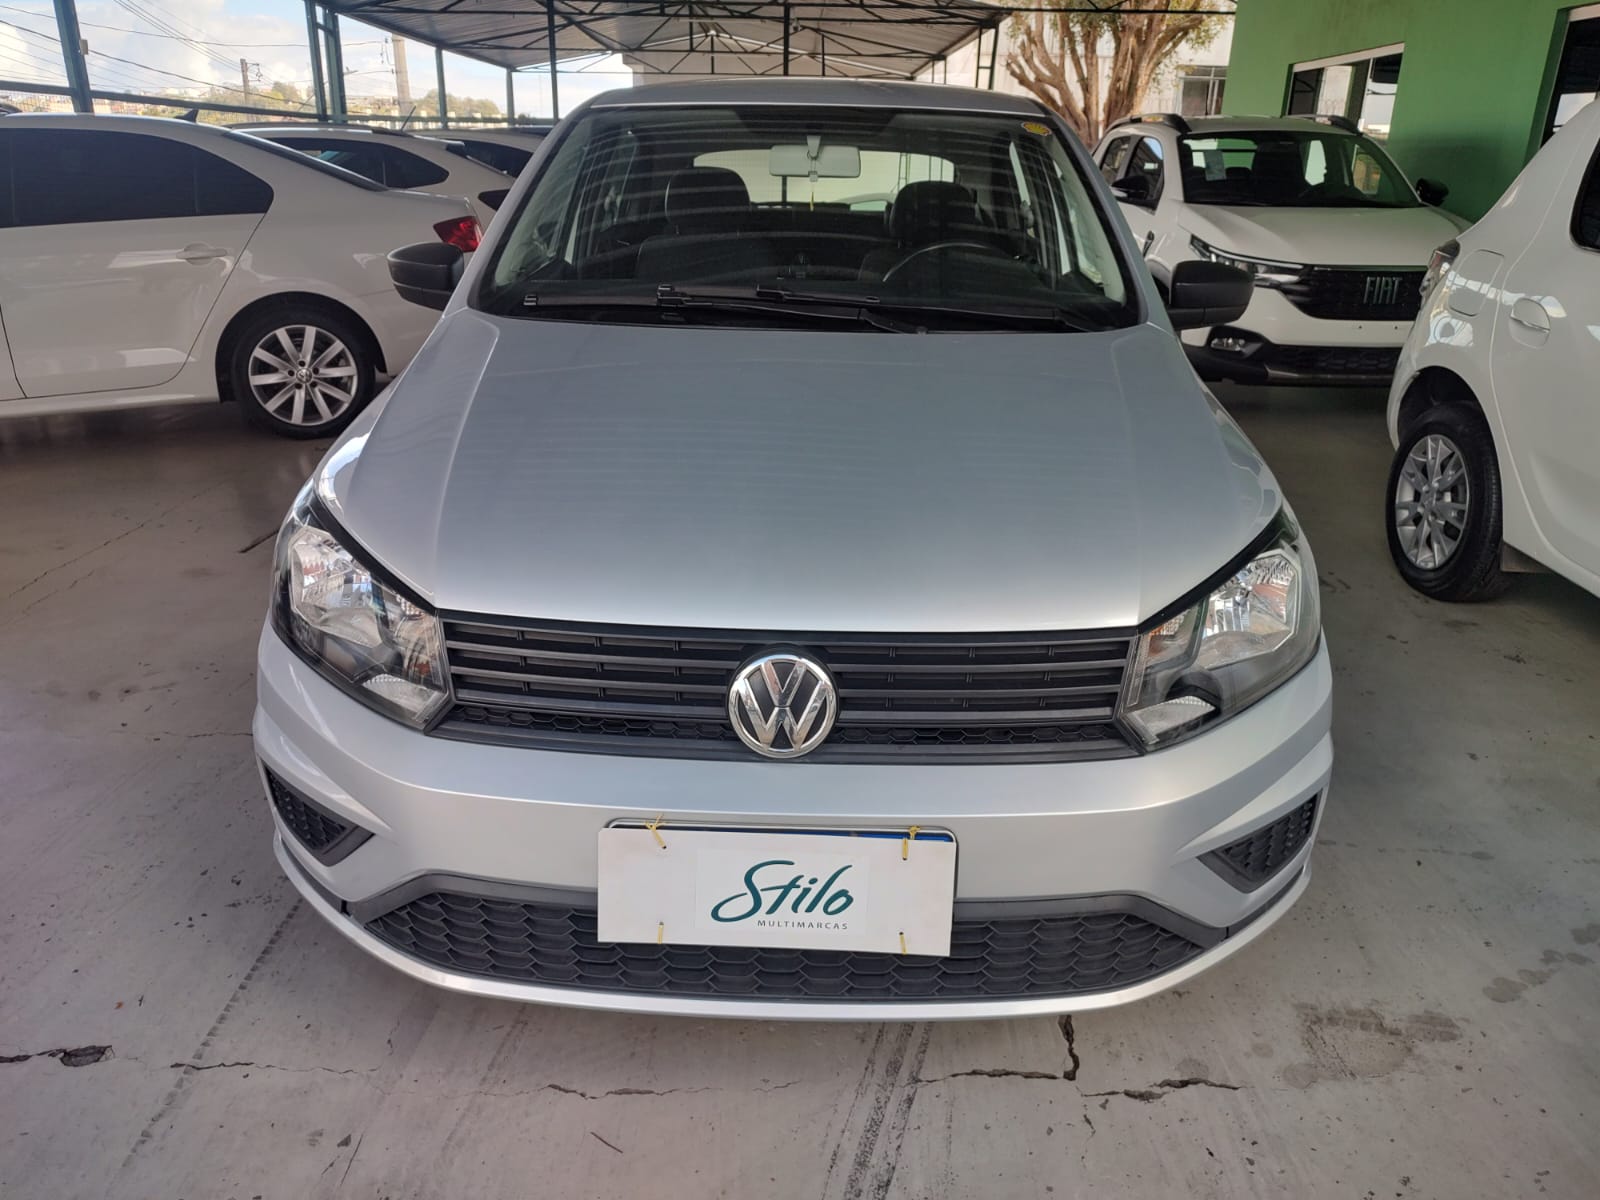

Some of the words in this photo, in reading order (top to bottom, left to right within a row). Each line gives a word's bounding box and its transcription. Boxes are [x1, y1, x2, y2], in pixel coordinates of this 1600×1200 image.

[1363, 276, 1403, 305] FIAT
[710, 860, 854, 922] Stilo
[757, 920, 849, 930] MULTIMARCAS
